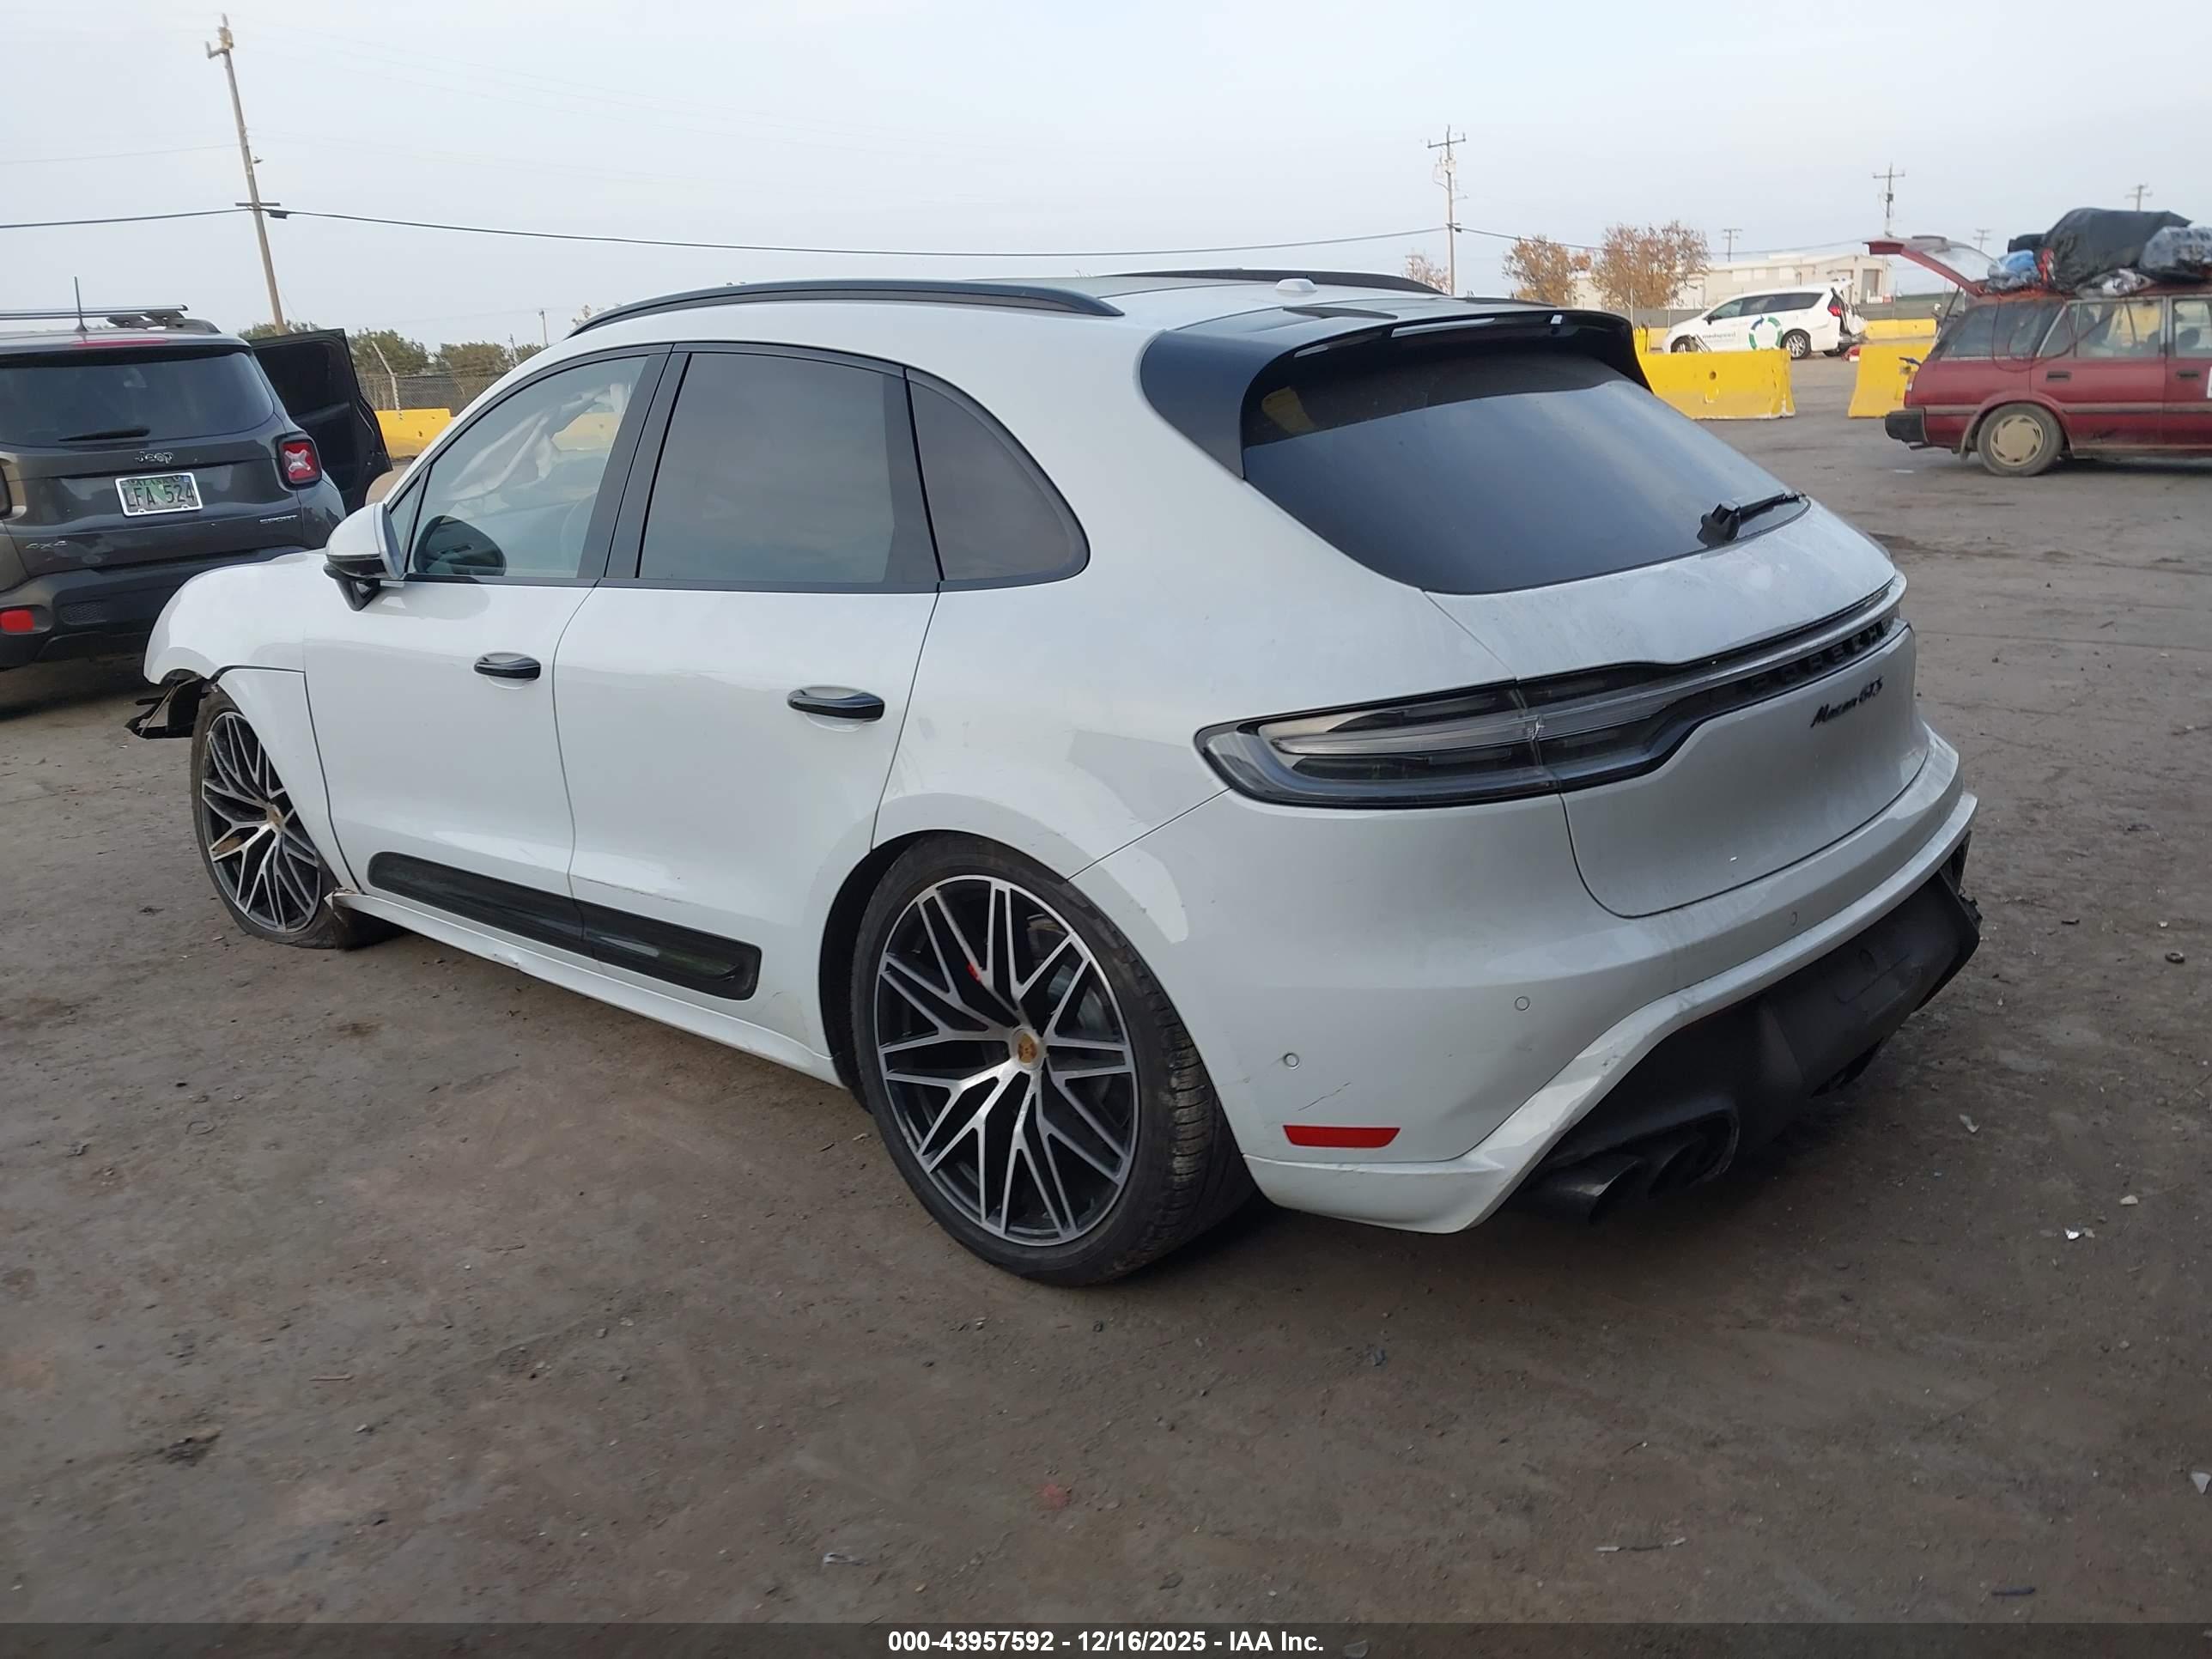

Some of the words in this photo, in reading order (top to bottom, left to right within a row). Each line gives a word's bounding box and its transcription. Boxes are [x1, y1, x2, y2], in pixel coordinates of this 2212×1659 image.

[134, 451, 173, 464] Jeep
[124, 486, 156, 507] LFA
[163, 483, 195, 504] 524
[1809, 697, 1858, 728] Macan
[1858, 676, 1884, 703] GTS
